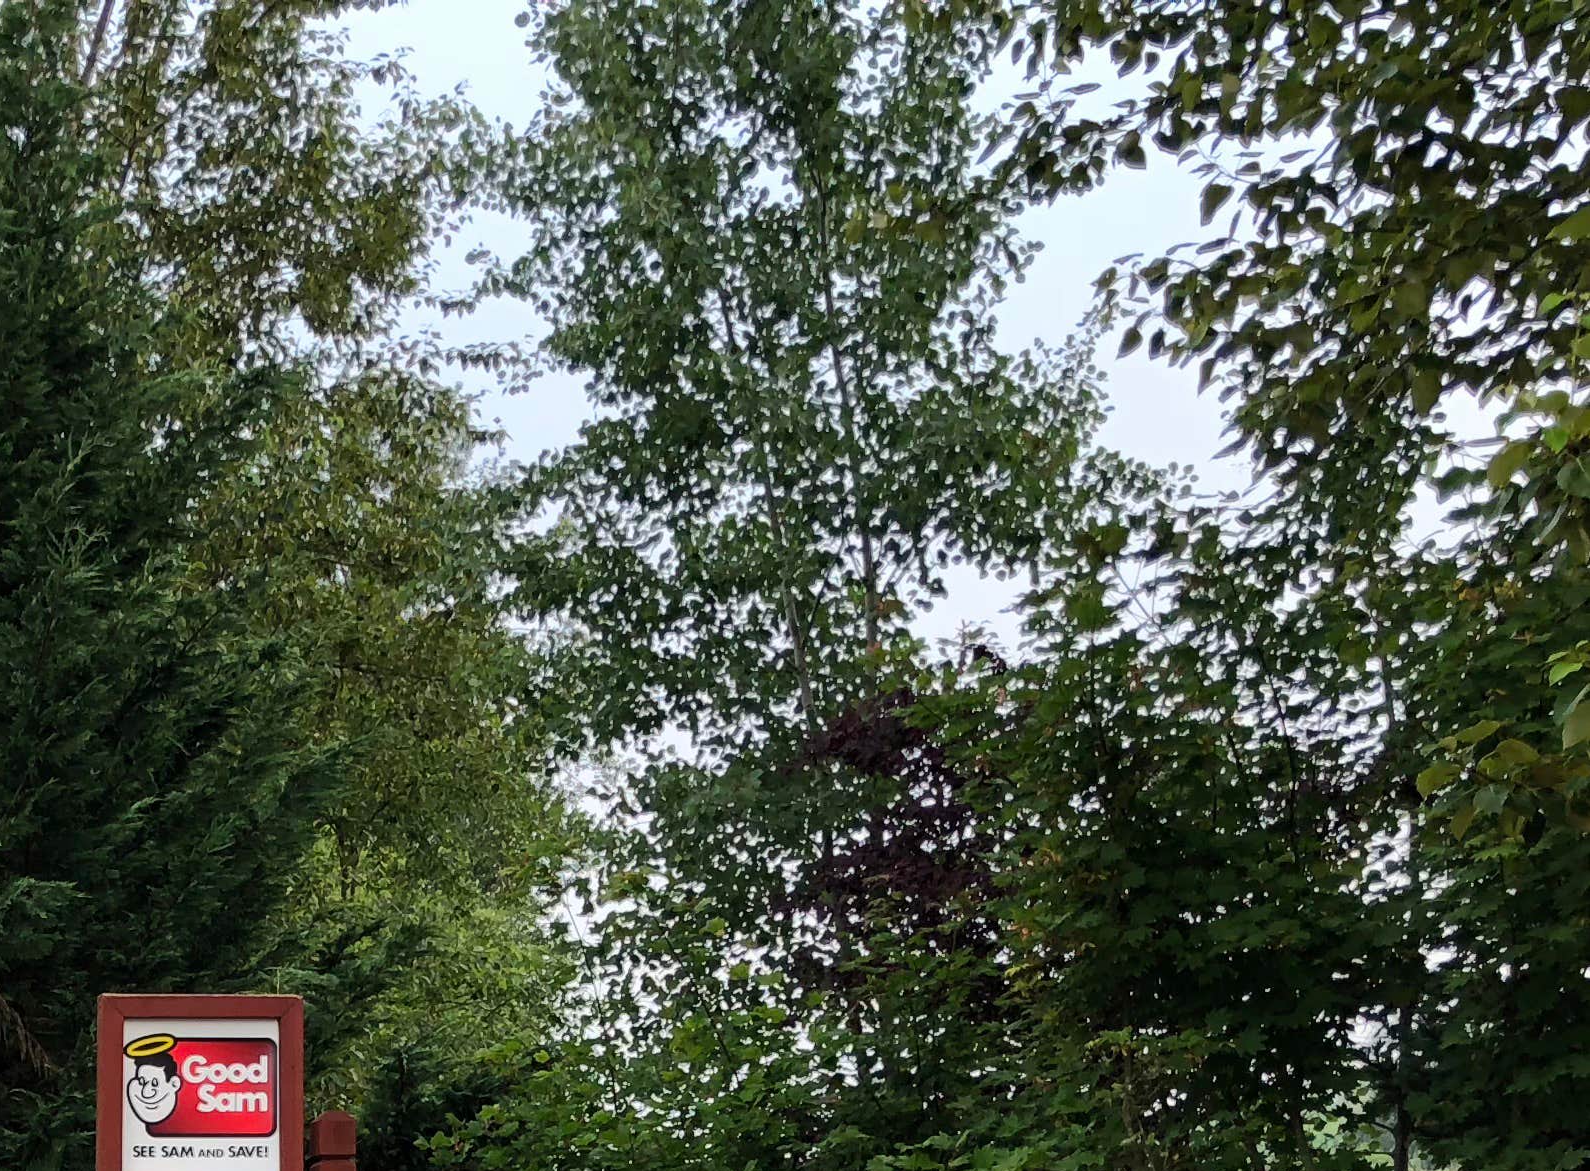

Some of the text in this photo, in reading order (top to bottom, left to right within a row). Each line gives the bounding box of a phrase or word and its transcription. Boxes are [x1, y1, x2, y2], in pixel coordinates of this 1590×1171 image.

[181, 1054, 269, 1084] Good
[196, 1084, 269, 1113] Sam
[132, 1145, 269, 1158] SEE SAM AND SAVE!
